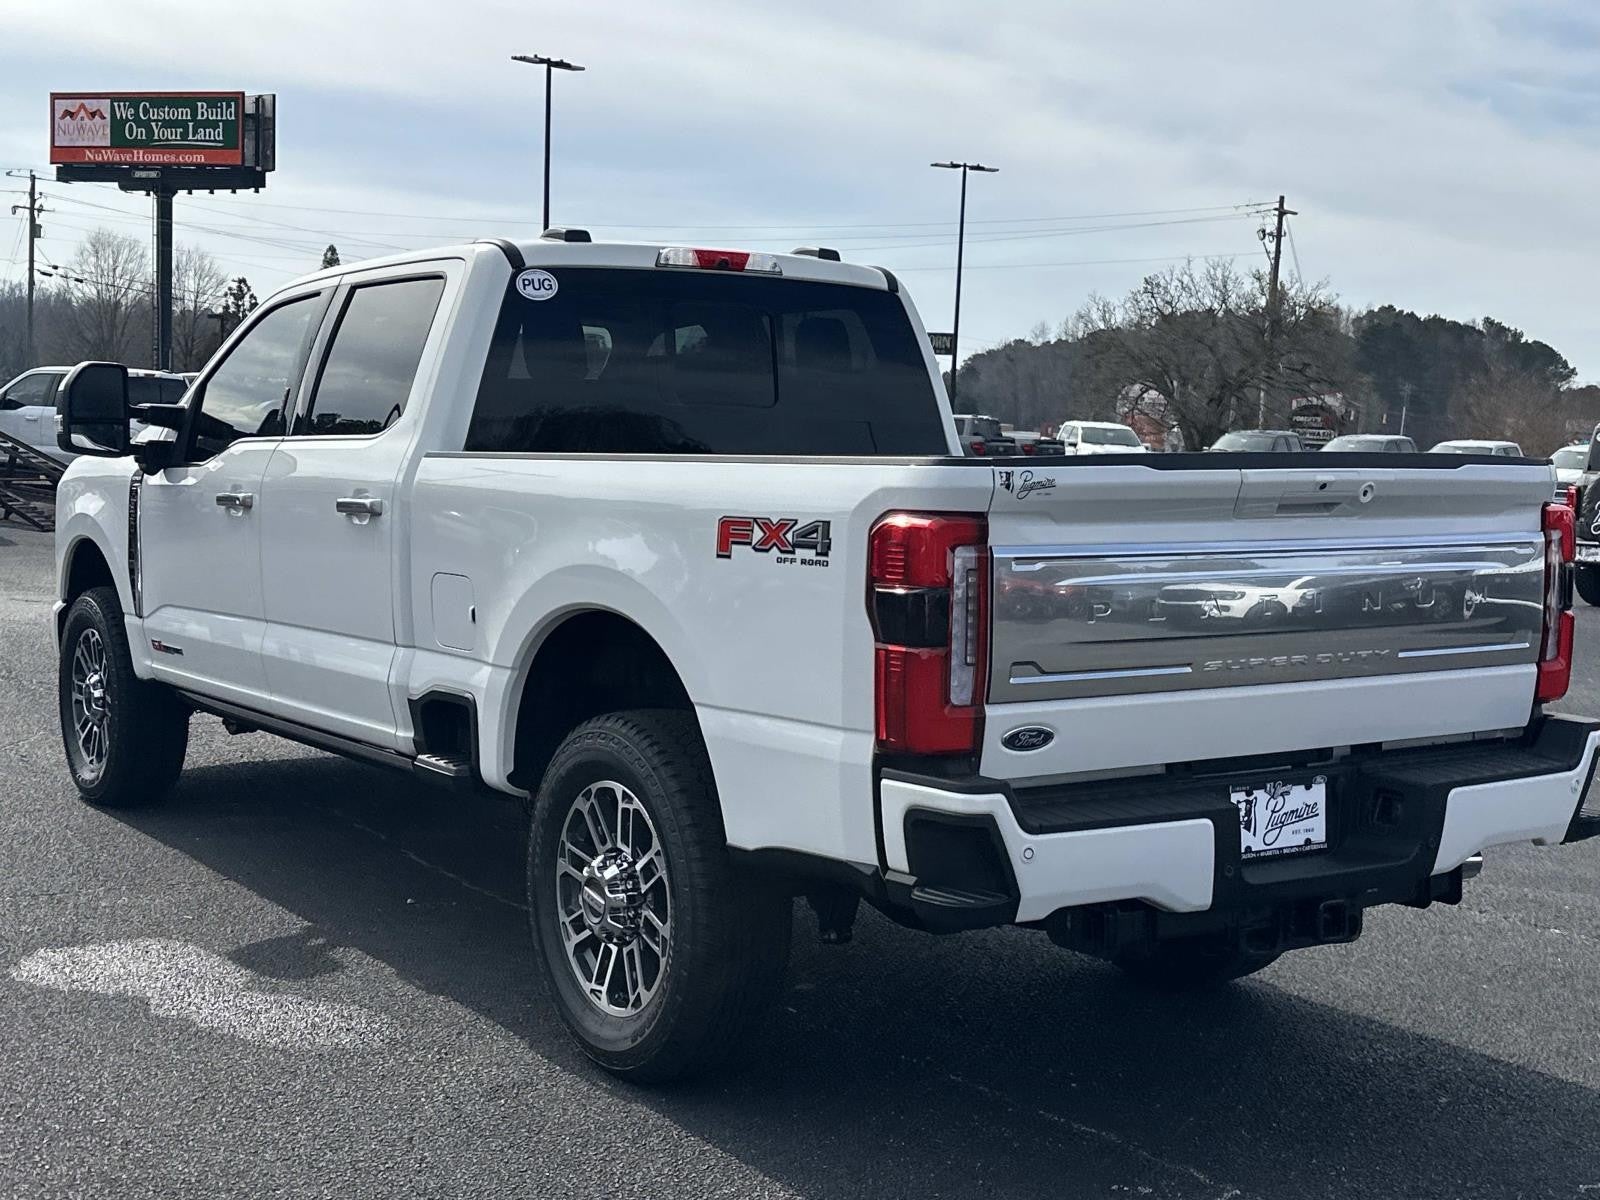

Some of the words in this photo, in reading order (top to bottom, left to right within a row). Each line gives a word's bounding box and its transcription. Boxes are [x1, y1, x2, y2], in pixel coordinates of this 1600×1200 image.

[113, 101, 135, 121] We
[138, 101, 192, 121] Custom
[196, 101, 235, 121] Build
[125, 122, 147, 140] On
[150, 122, 183, 140] Your
[187, 122, 223, 141] Land
[85, 150, 205, 162] NuWaveHomes.com
[522, 278, 553, 291] PUG
[716, 516, 831, 559] FX4
[776, 556, 797, 565] OFF
[800, 558, 829, 567] ROAD
[1203, 654, 1309, 672] SUPER
[1315, 649, 1391, 665] DUTY
[1015, 731, 1045, 747] Ford
[1263, 793, 1320, 846] Pugmire
